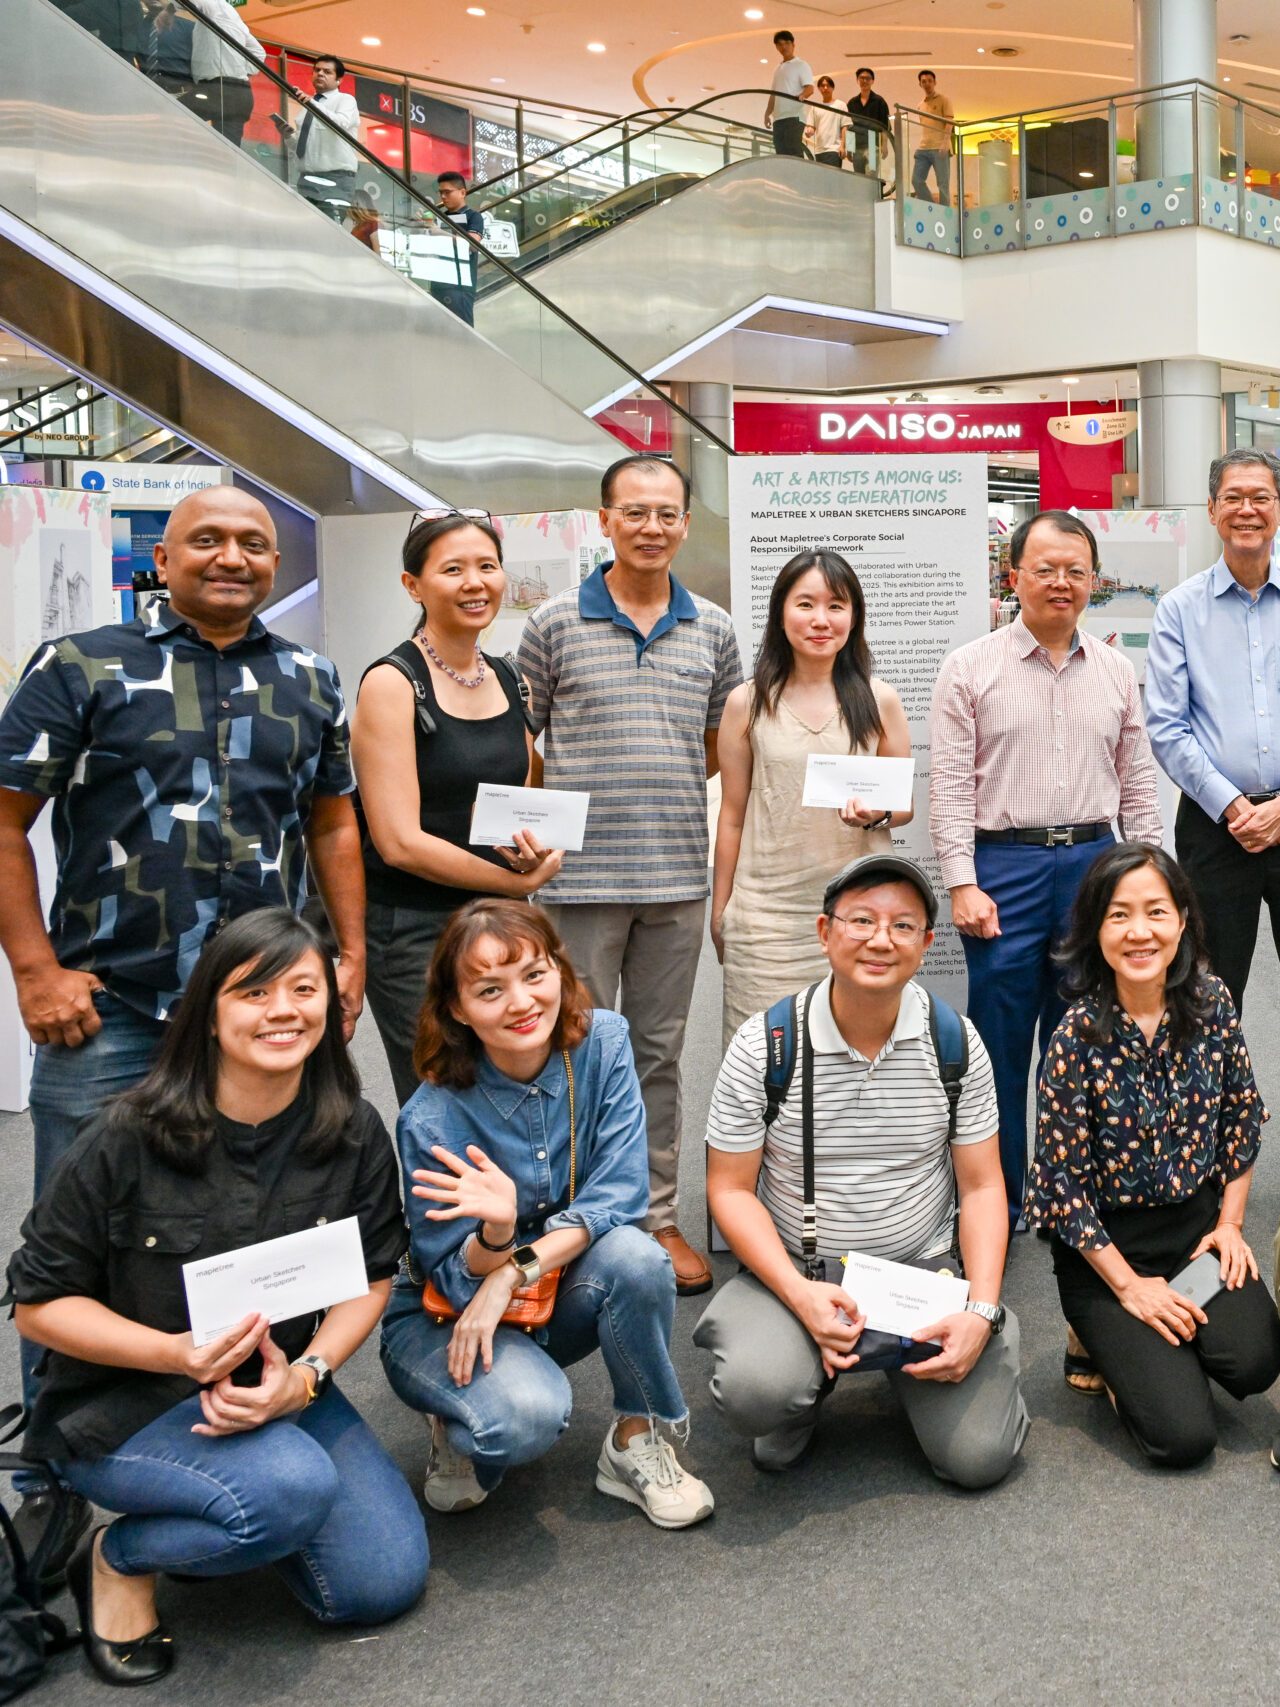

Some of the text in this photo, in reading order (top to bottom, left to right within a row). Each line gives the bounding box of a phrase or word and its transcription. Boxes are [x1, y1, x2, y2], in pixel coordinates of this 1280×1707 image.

[820, 413, 1020, 440] DAISO JAPAN
[1090, 421, 1095, 434] 1
[113, 478, 212, 490] State Bank of India
[752, 470, 962, 487] ART & ARTISTS AMONG US:
[769, 490, 947, 506] ACROSS GENERATIONS
[751, 511, 807, 519] MAPLETREE
[855, 509, 910, 517] SKETCHERS
[780, 535, 830, 544] Mapletree's
[833, 534, 876, 542] Corporate
[879, 533, 904, 541] Social
[751, 544, 863, 554] Responsibility Framework
[912, 638, 934, 646] global
[196, 1262, 234, 1278] mapletree
[250, 1263, 306, 1284] Urban Sketchers
[263, 1275, 297, 1290] Singapore
